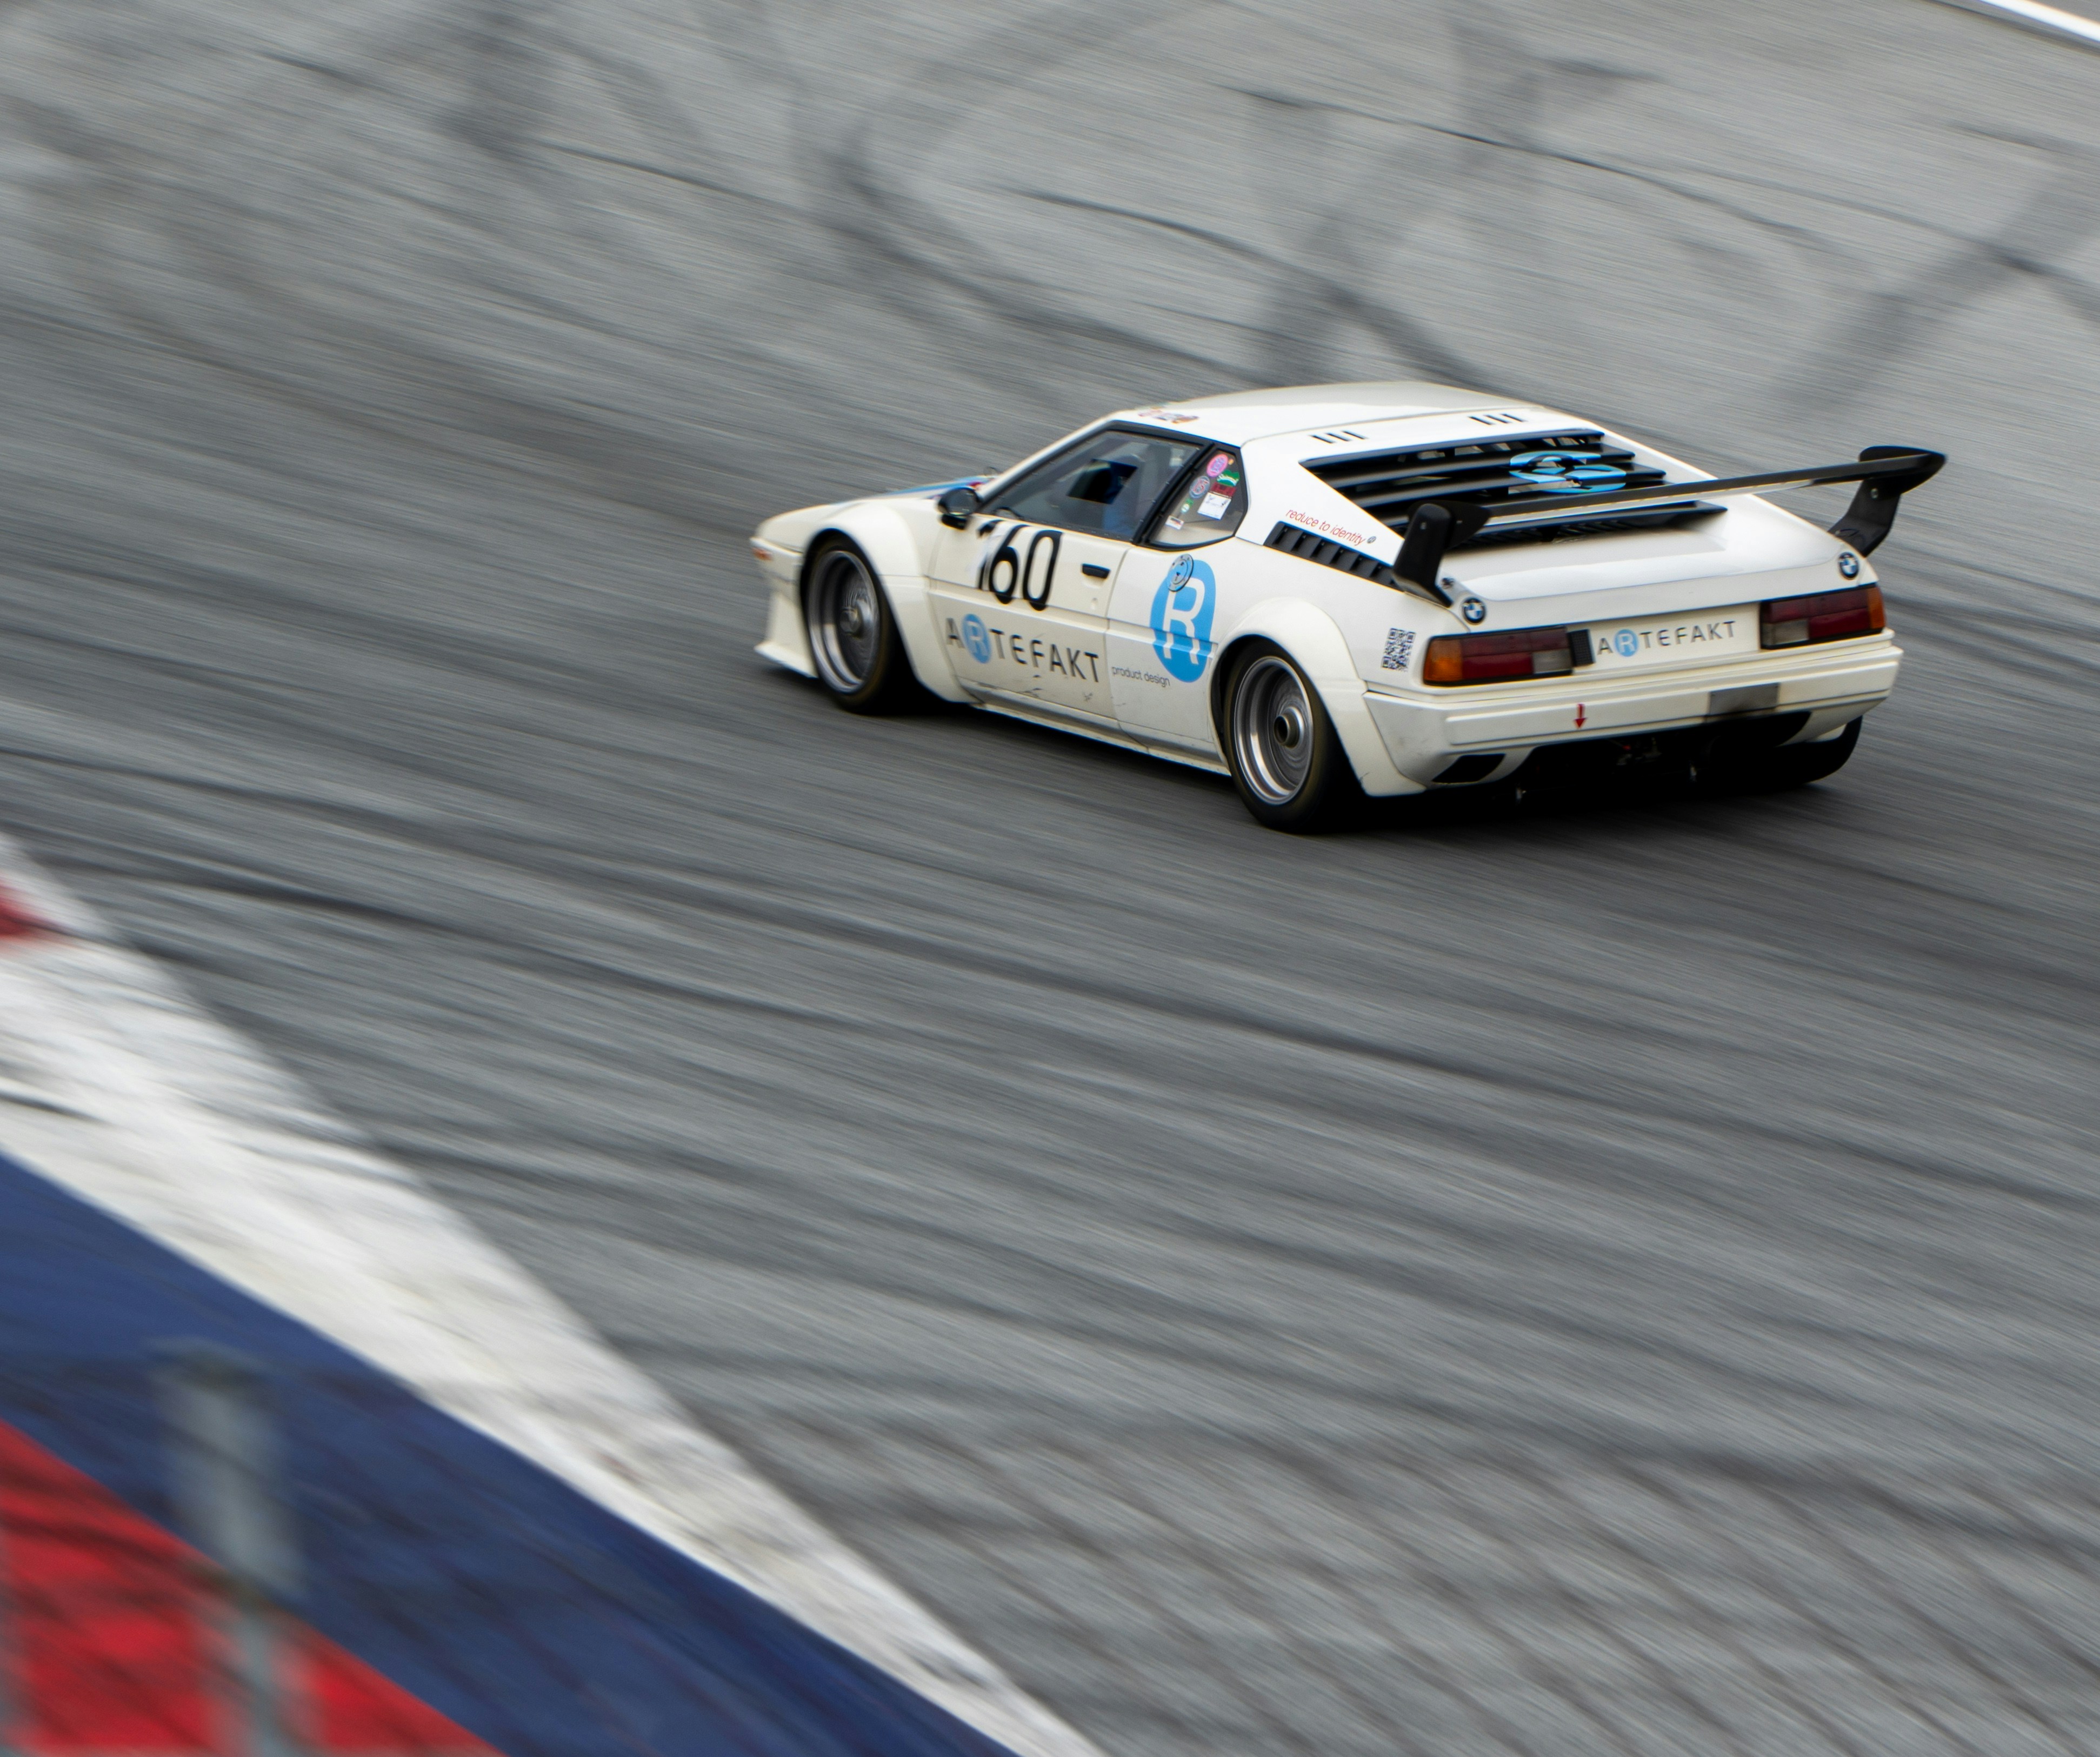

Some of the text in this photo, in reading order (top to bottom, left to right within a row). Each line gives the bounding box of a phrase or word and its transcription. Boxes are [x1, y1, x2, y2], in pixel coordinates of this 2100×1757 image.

[1286, 509, 1319, 527] reduce
[1319, 521, 1331, 531] to
[1330, 525, 1366, 546] identity
[945, 614, 1099, 683] ARTEFAKT
[1597, 621, 1736, 657] ARTEFAKT
[1112, 666, 1170, 688] product design
